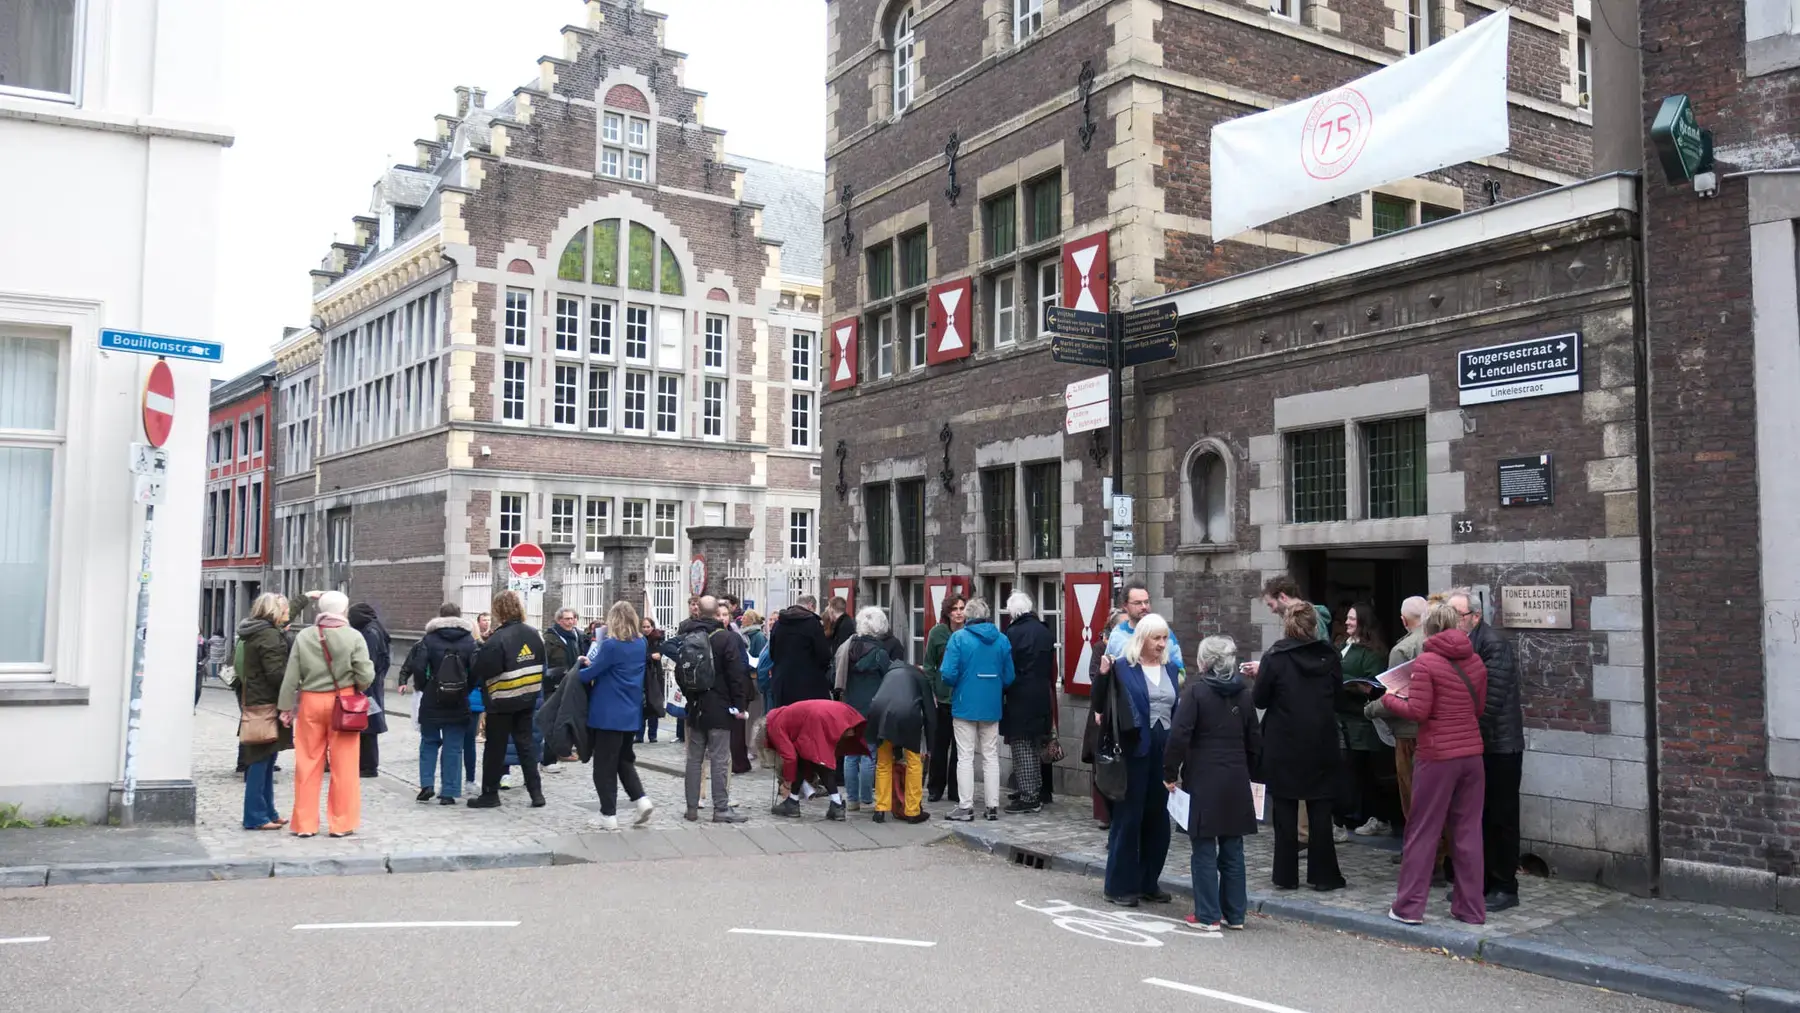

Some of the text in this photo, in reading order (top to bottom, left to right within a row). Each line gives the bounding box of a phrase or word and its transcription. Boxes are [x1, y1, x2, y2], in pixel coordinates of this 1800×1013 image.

[1320, 114, 1351, 155] 75
[1467, 344, 1552, 366] Tongersestraat
[1479, 357, 1568, 378] Lenculenstraat
[1490, 383, 1544, 397] Linkelestraot
[1458, 520, 1473, 533] 33
[1504, 589, 1568, 599] TONEELACADEMIE
[1523, 600, 1568, 610] MAASTRICHT
[516, 653, 535, 663] adidas
